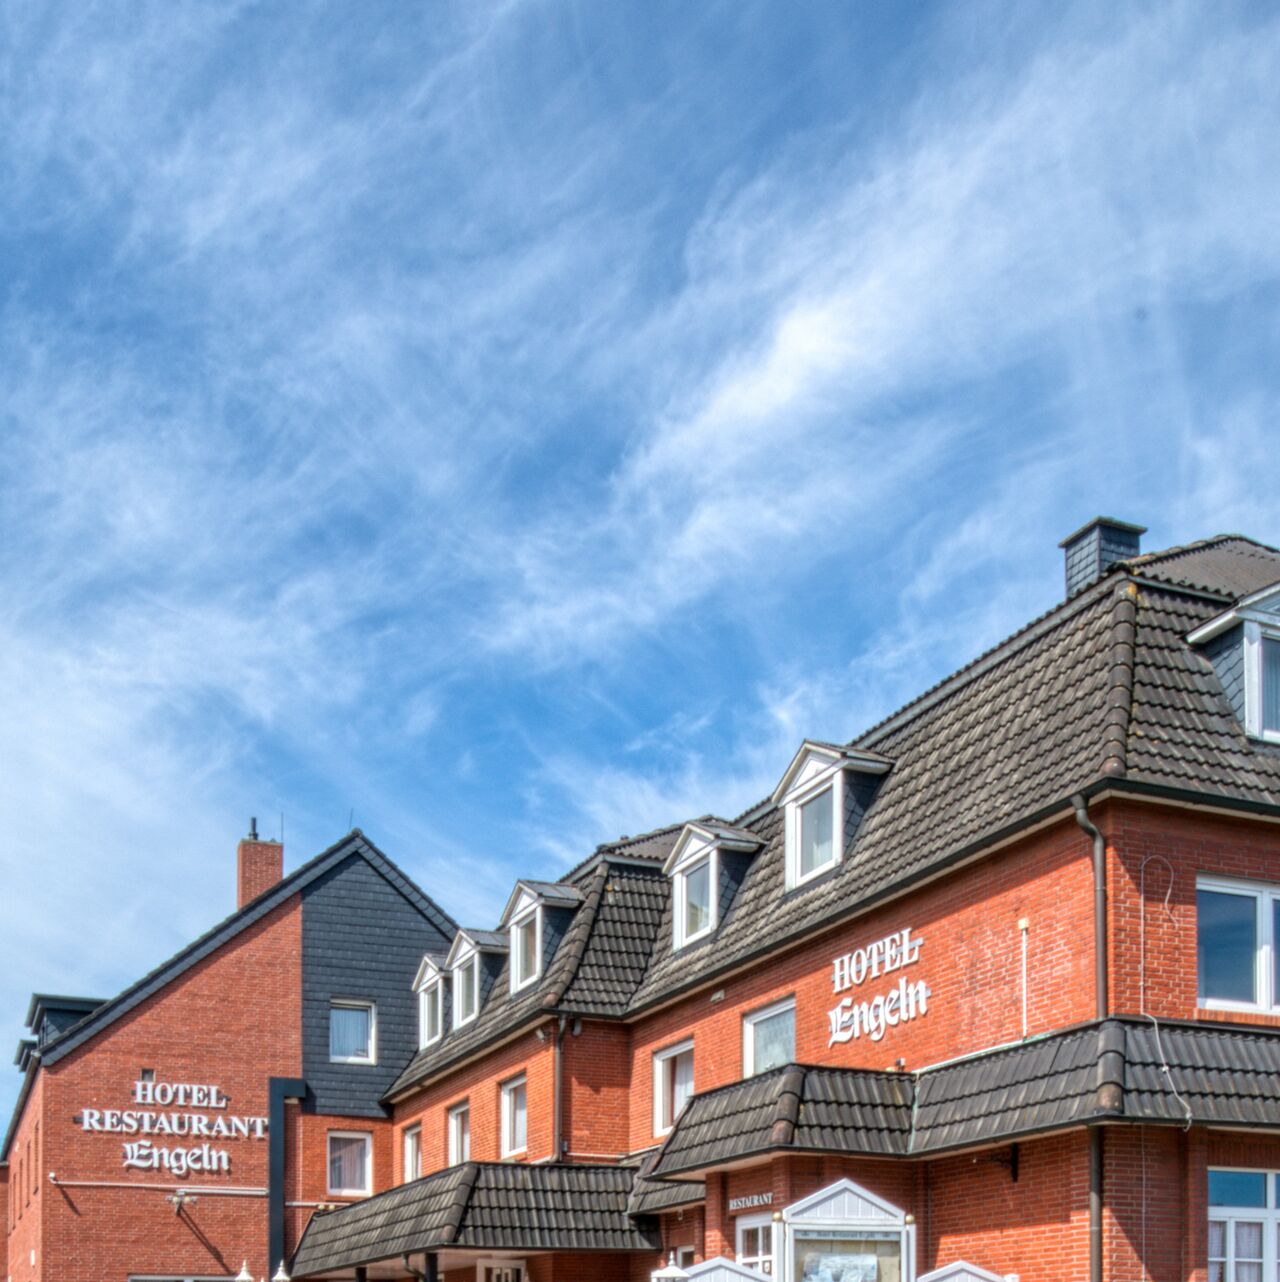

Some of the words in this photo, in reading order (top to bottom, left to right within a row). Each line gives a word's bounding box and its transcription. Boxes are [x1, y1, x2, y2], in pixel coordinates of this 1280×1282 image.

[832, 928, 920, 993] HOTEL
[827, 976, 928, 1049] Engeln
[134, 1081, 226, 1108] HOTEL
[81, 1108, 268, 1138] RESTAURANT
[123, 1139, 230, 1175] Engeln
[729, 1193, 773, 1211] RESTAURANT
